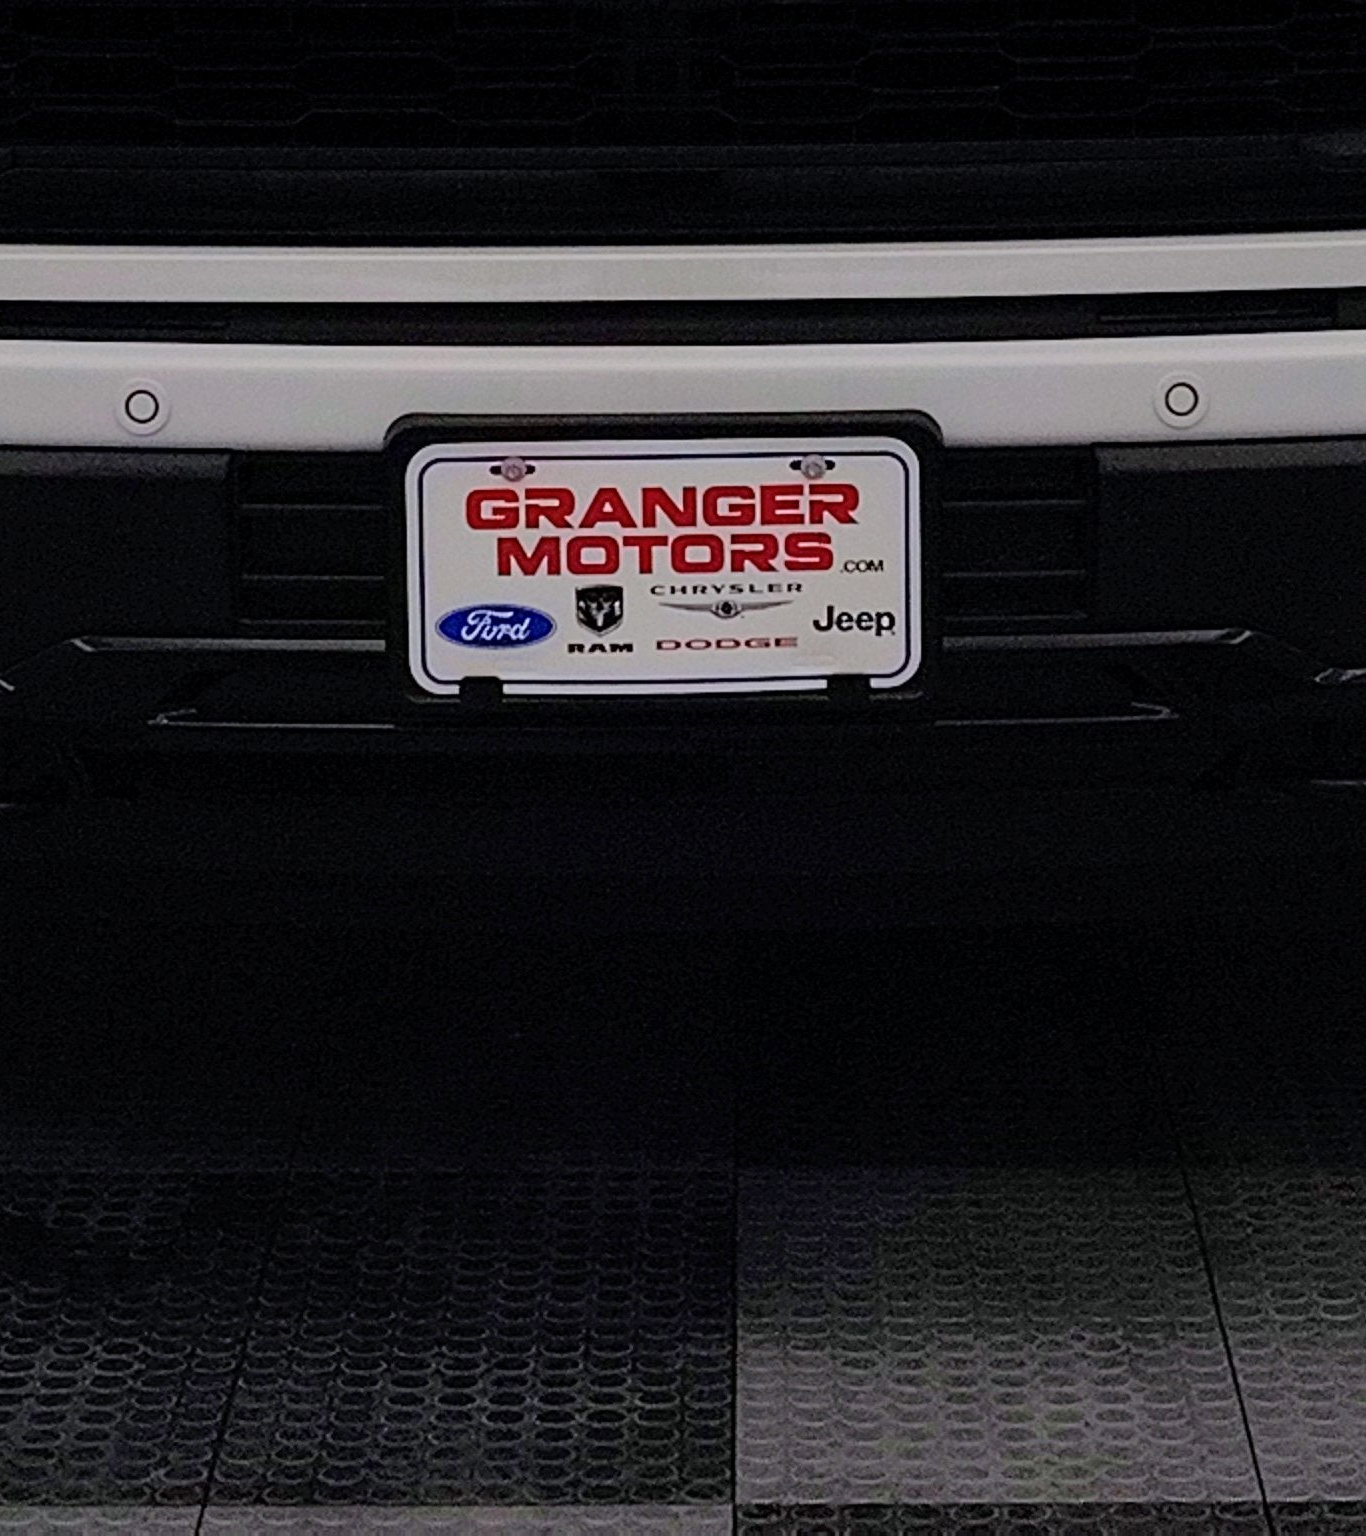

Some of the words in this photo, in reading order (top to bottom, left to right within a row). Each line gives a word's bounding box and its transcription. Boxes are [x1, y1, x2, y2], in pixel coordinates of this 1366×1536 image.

[465, 483, 860, 531] GRANGER
[496, 531, 834, 577] MOTORS
[840, 559, 884, 573] .COM
[650, 582, 804, 596] CHRYSLER
[460, 609, 532, 641] Ford
[812, 605, 896, 636] Jeep
[567, 643, 634, 654] RAM
[656, 636, 799, 651] DODGE
